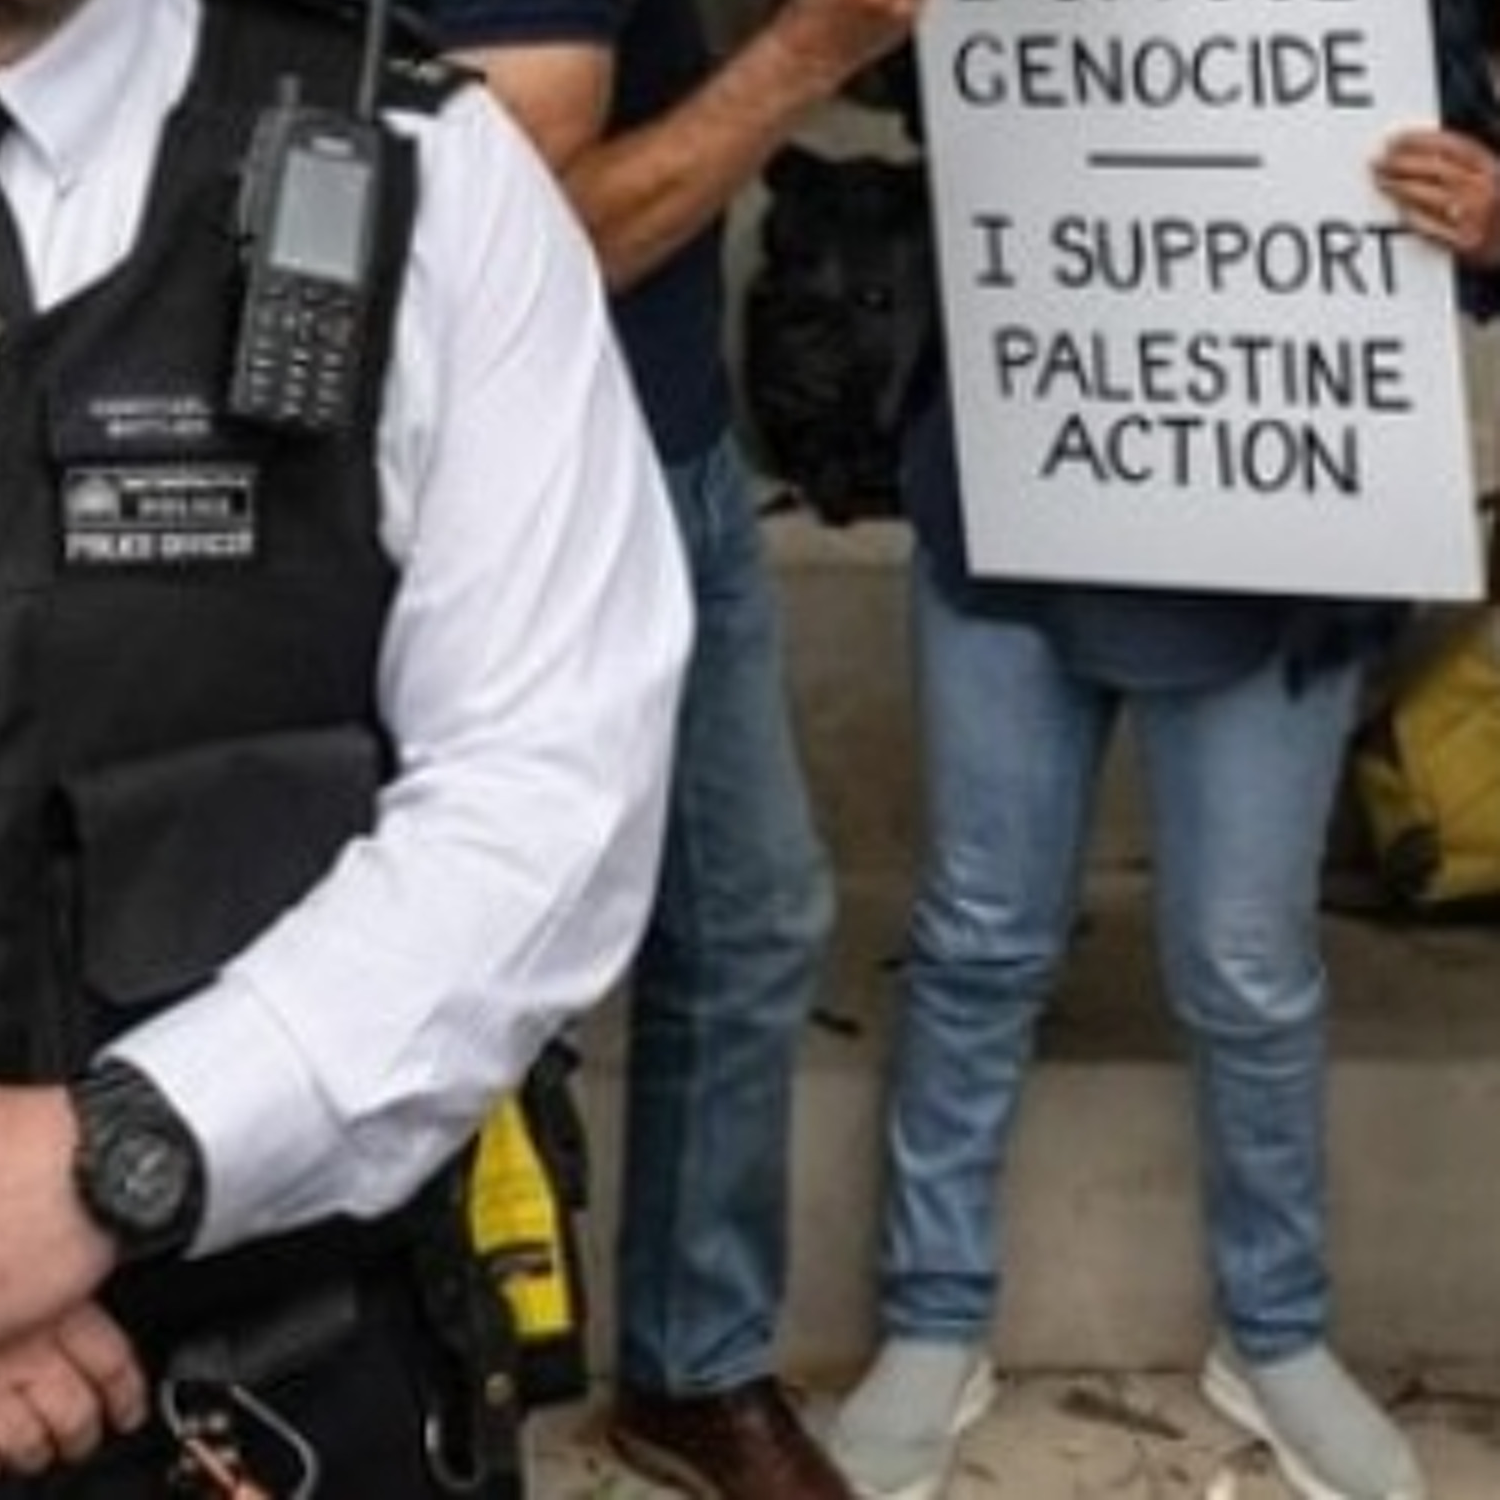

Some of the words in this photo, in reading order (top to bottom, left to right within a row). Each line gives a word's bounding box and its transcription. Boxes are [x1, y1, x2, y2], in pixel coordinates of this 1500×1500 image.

[950, 28, 1374, 110] GENOCIDE
[970, 212, 1016, 290] I
[1048, 213, 1406, 297] SUPPORT
[990, 322, 1413, 414] PALESTINE
[1038, 411, 1362, 498] ACTION
